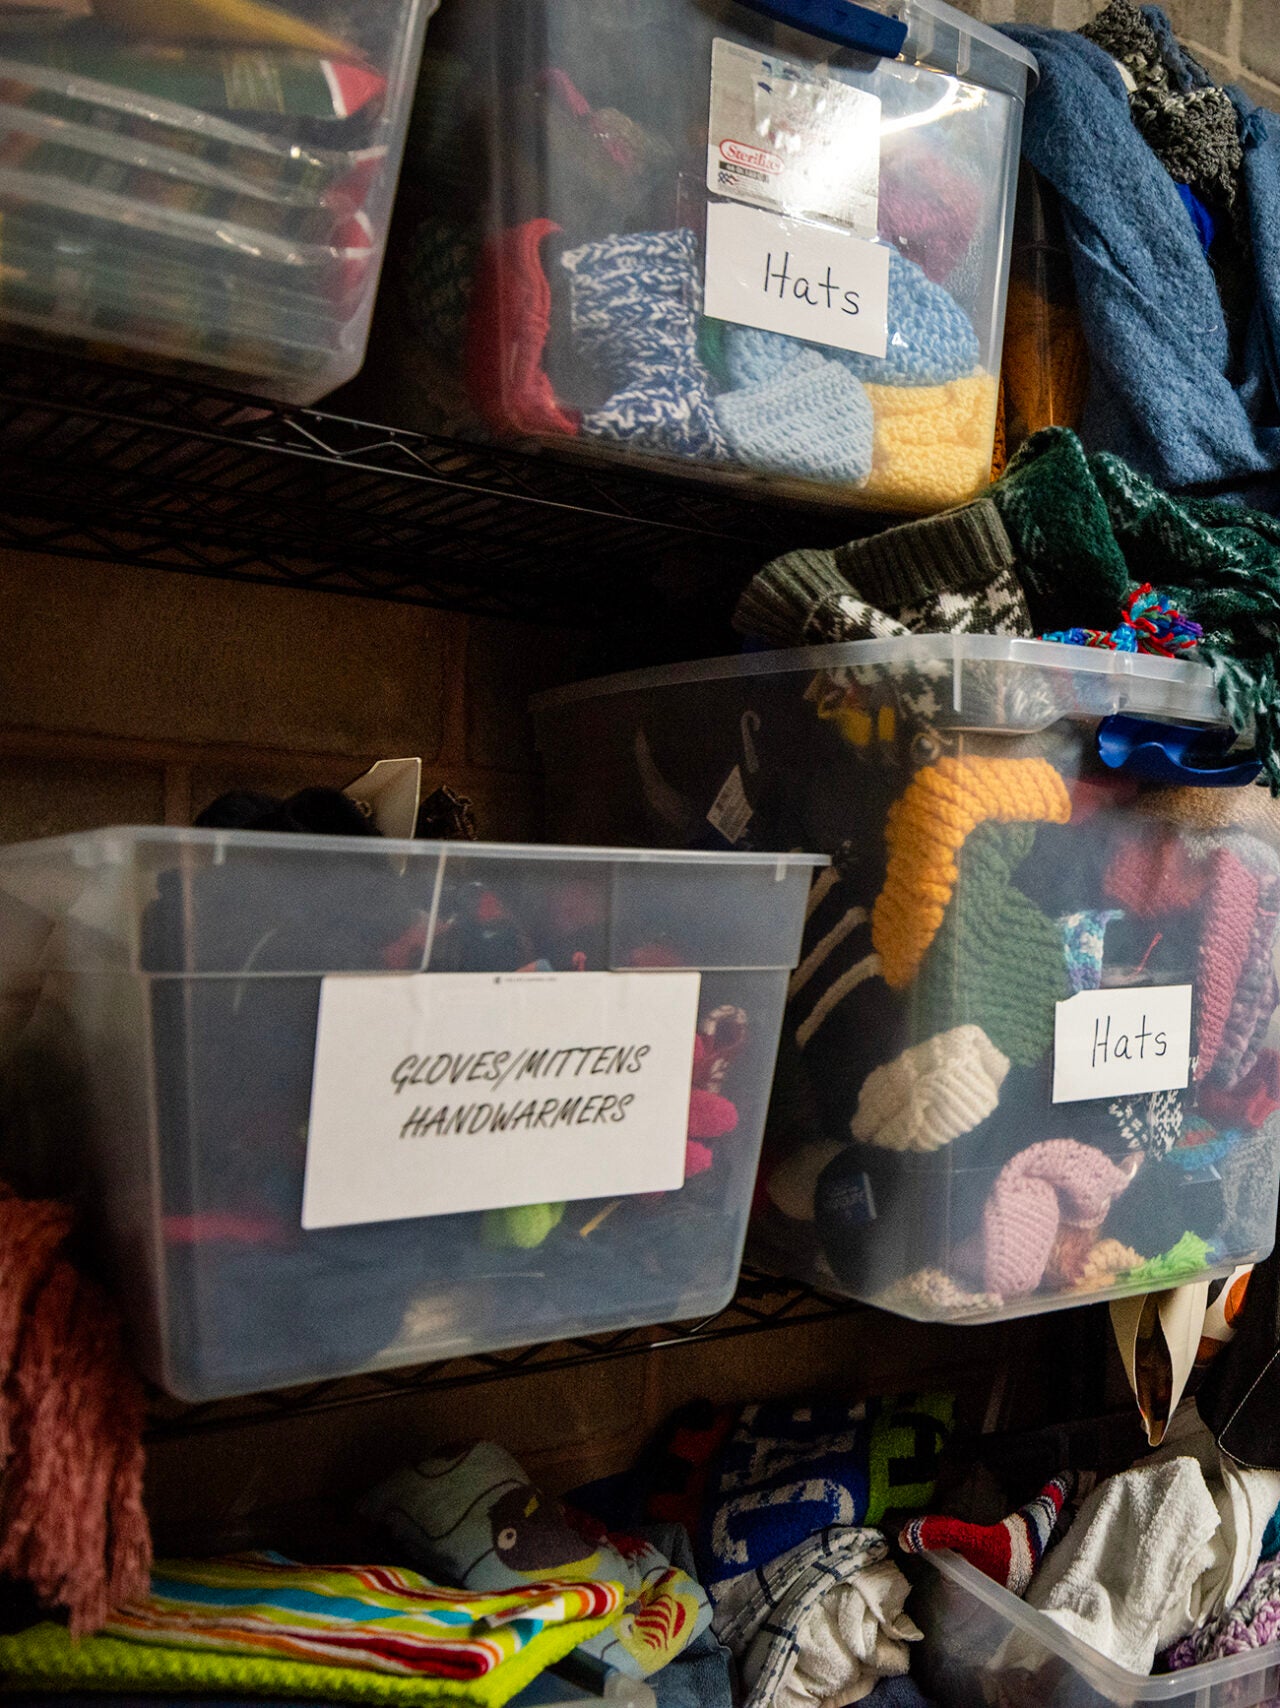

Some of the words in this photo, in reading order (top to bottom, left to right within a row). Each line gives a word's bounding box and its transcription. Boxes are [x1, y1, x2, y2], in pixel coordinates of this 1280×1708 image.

[764, 251, 860, 315] Hats
[1092, 1014, 1167, 1067] Hats
[390, 1044, 651, 1095] GLOVES/MITTENS
[399, 1093, 636, 1139] HANDWARMERS
